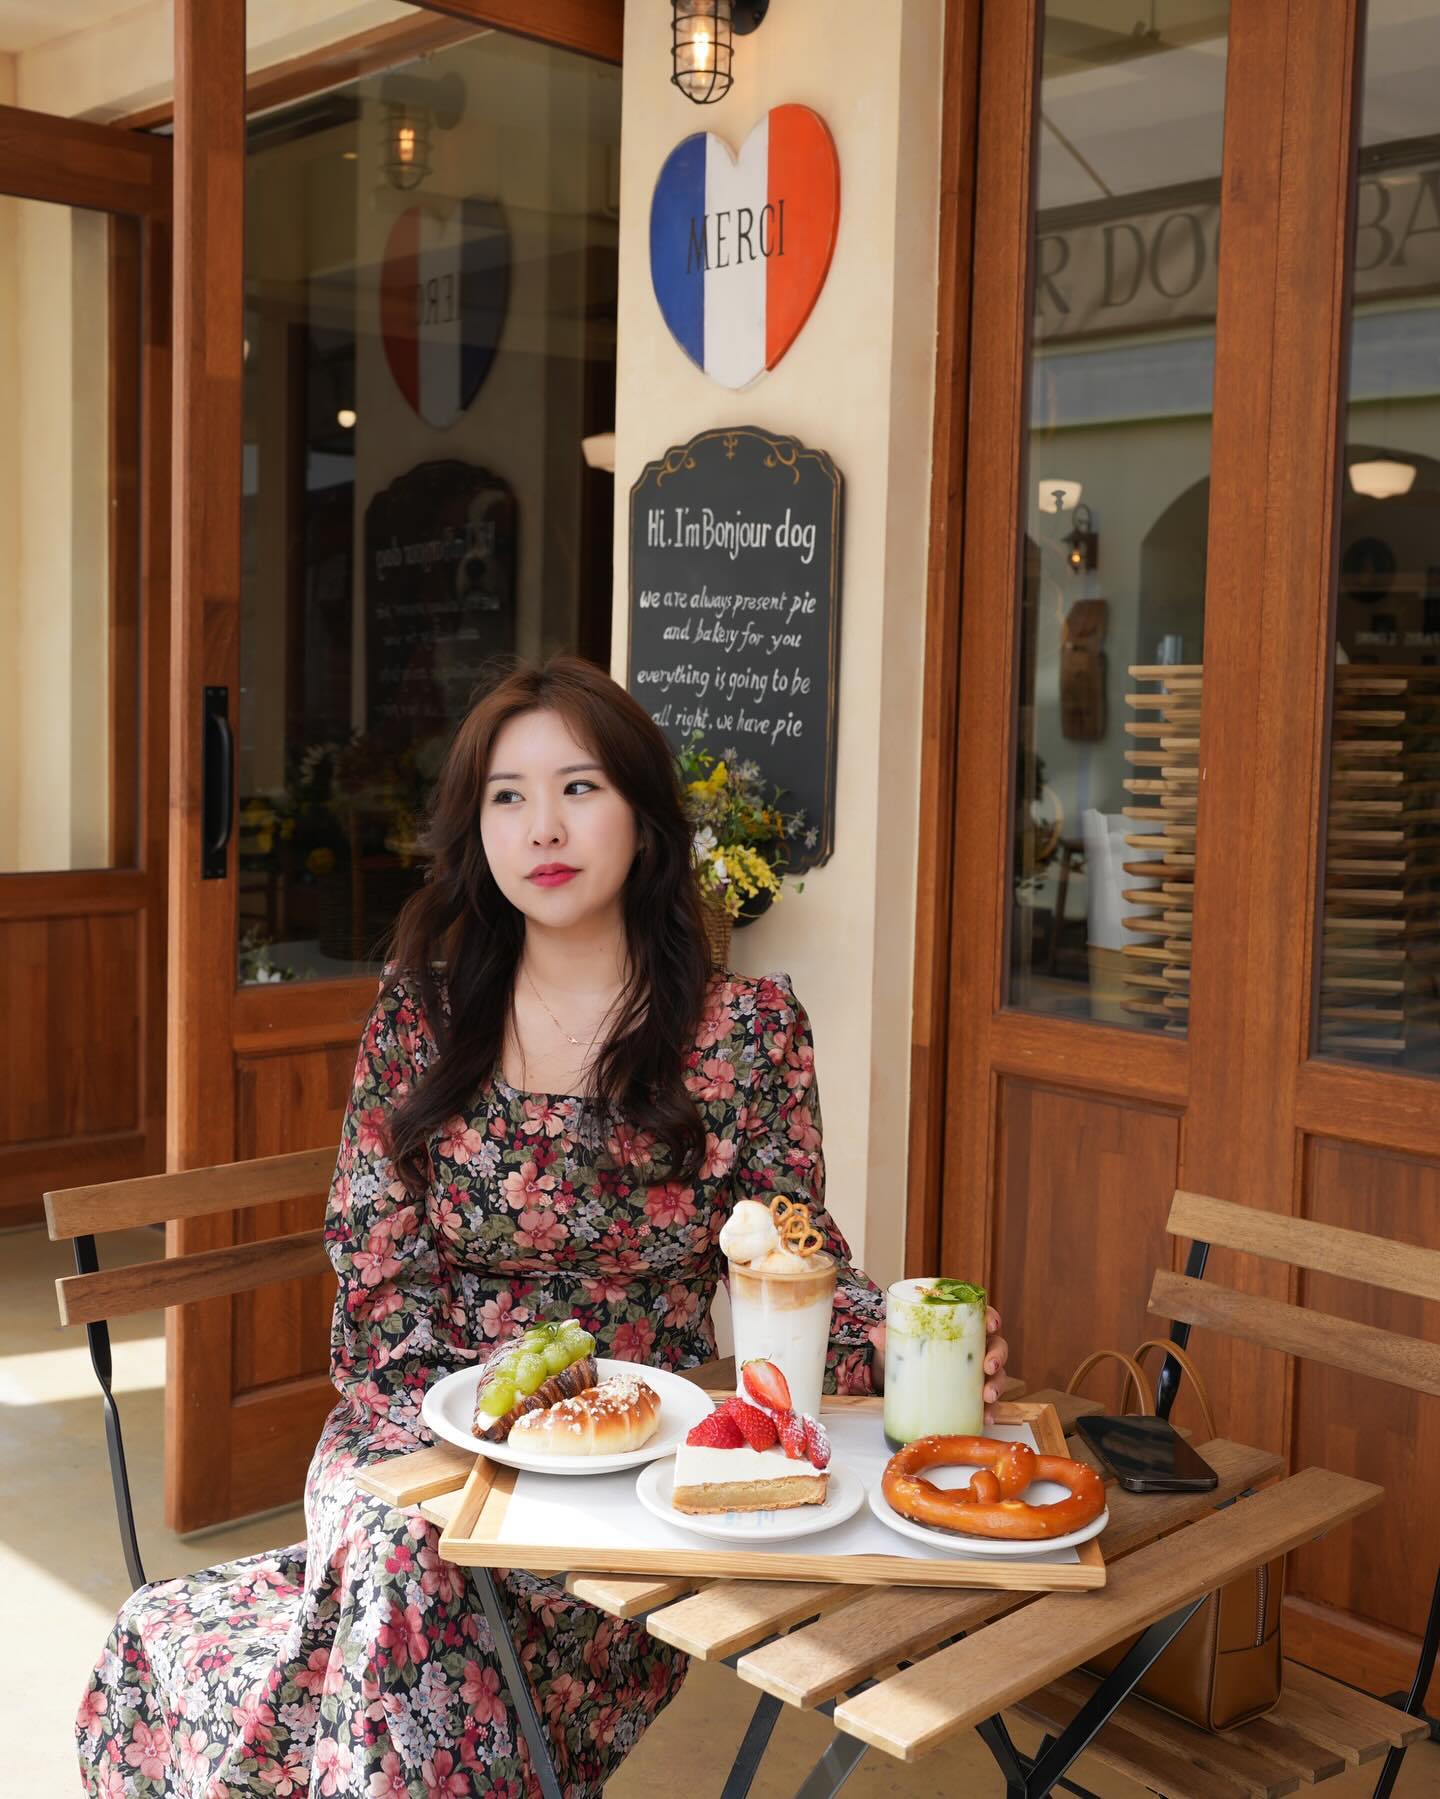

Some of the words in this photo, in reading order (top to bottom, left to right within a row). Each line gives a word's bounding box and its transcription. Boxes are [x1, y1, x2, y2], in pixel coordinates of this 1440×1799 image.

[687, 199, 785, 275] MERCI
[1099, 212, 1221, 309] DO
[674, 507, 700, 548] I'm
[702, 508, 772, 560] Bonjour
[775, 508, 816, 564] dog
[639, 590, 660, 609] we
[663, 591, 688, 608] are
[690, 585, 732, 619] always
[732, 592, 787, 618] present
[785, 591, 816, 625] pie
[663, 617, 691, 641] and
[691, 618, 739, 653] bakery
[736, 621, 765, 653] for
[766, 633, 802, 655] you
[637, 664, 710, 698] everything
[714, 666, 726, 691] is
[726, 667, 768, 704] going
[772, 668, 788, 692] to
[790, 667, 811, 696] be
[652, 703, 673, 727] all
[716, 713, 734, 731] we
[736, 708, 770, 734] have
[771, 711, 803, 746] pie
